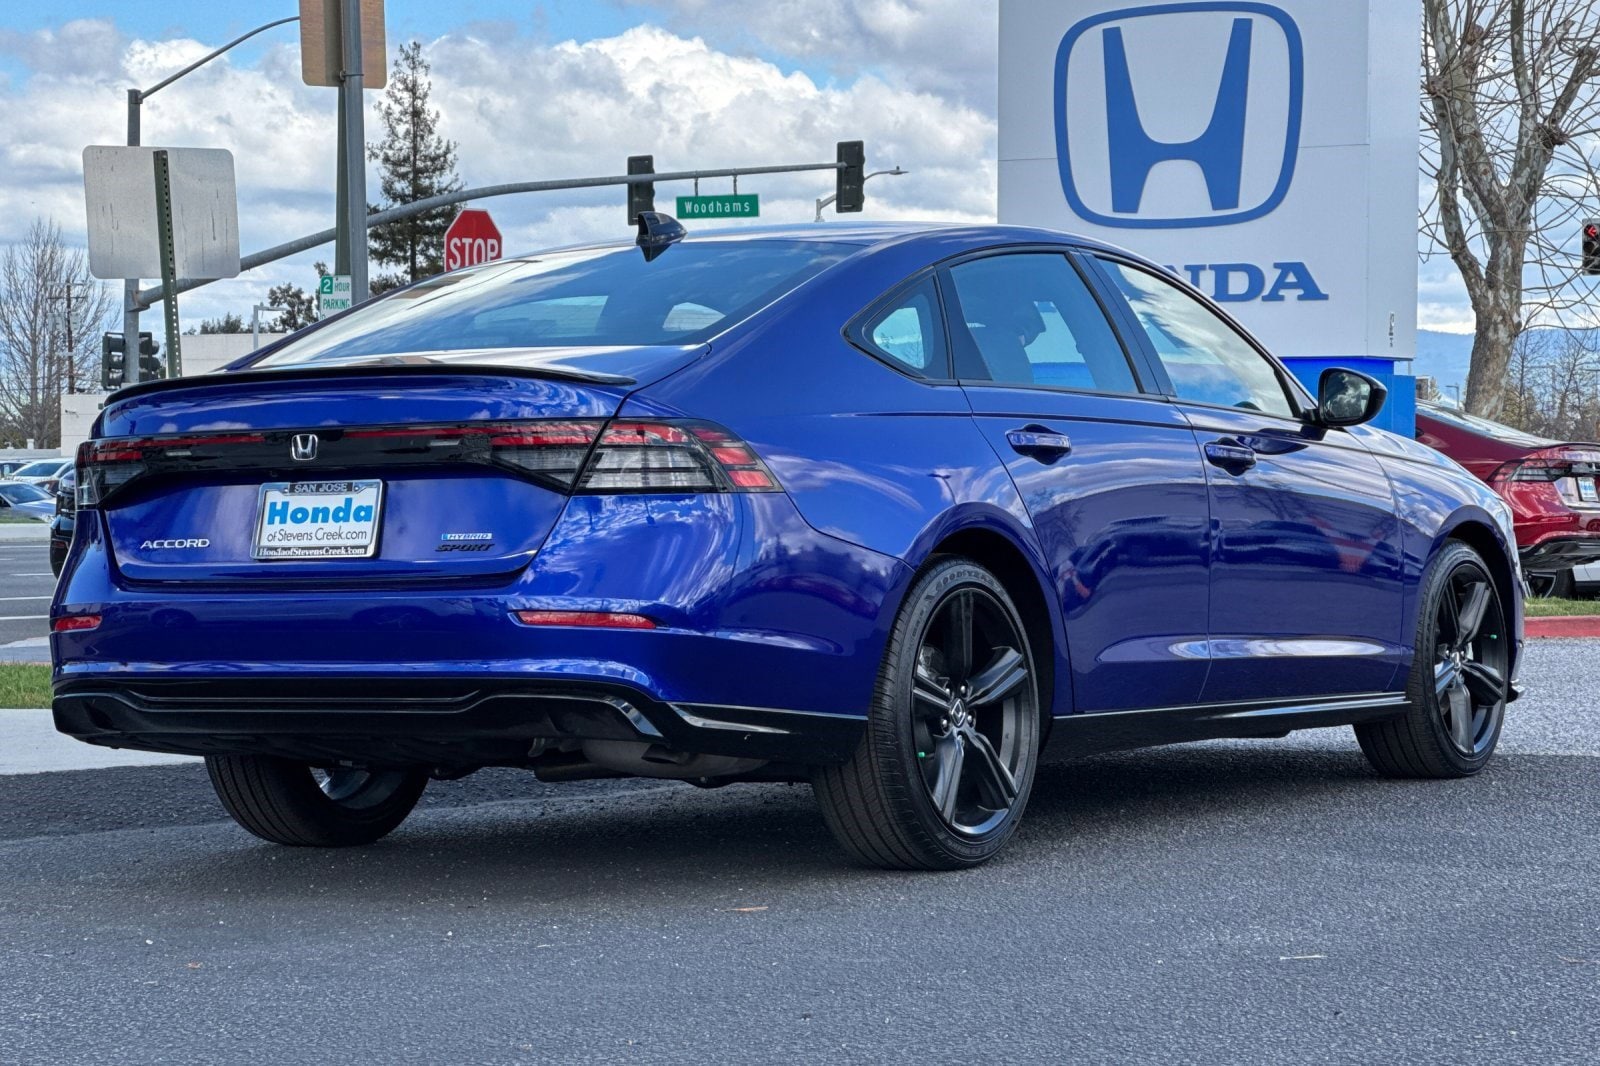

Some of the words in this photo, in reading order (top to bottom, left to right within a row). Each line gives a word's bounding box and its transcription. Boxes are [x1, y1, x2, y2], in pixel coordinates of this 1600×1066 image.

[684, 200, 750, 213] Woodhams
[449, 237, 499, 269] STOP
[323, 279, 331, 292] 2
[334, 282, 350, 292] HOUR
[322, 299, 350, 310] PARKING
[294, 484, 317, 493] SAN
[319, 482, 347, 492] JOSE
[267, 497, 373, 525] Honda
[266, 532, 278, 542] of
[278, 528, 313, 542] Stevens
[314, 525, 367, 541] Creek.com
[140, 538, 210, 549] ACCORD
[435, 543, 495, 553] SPORT
